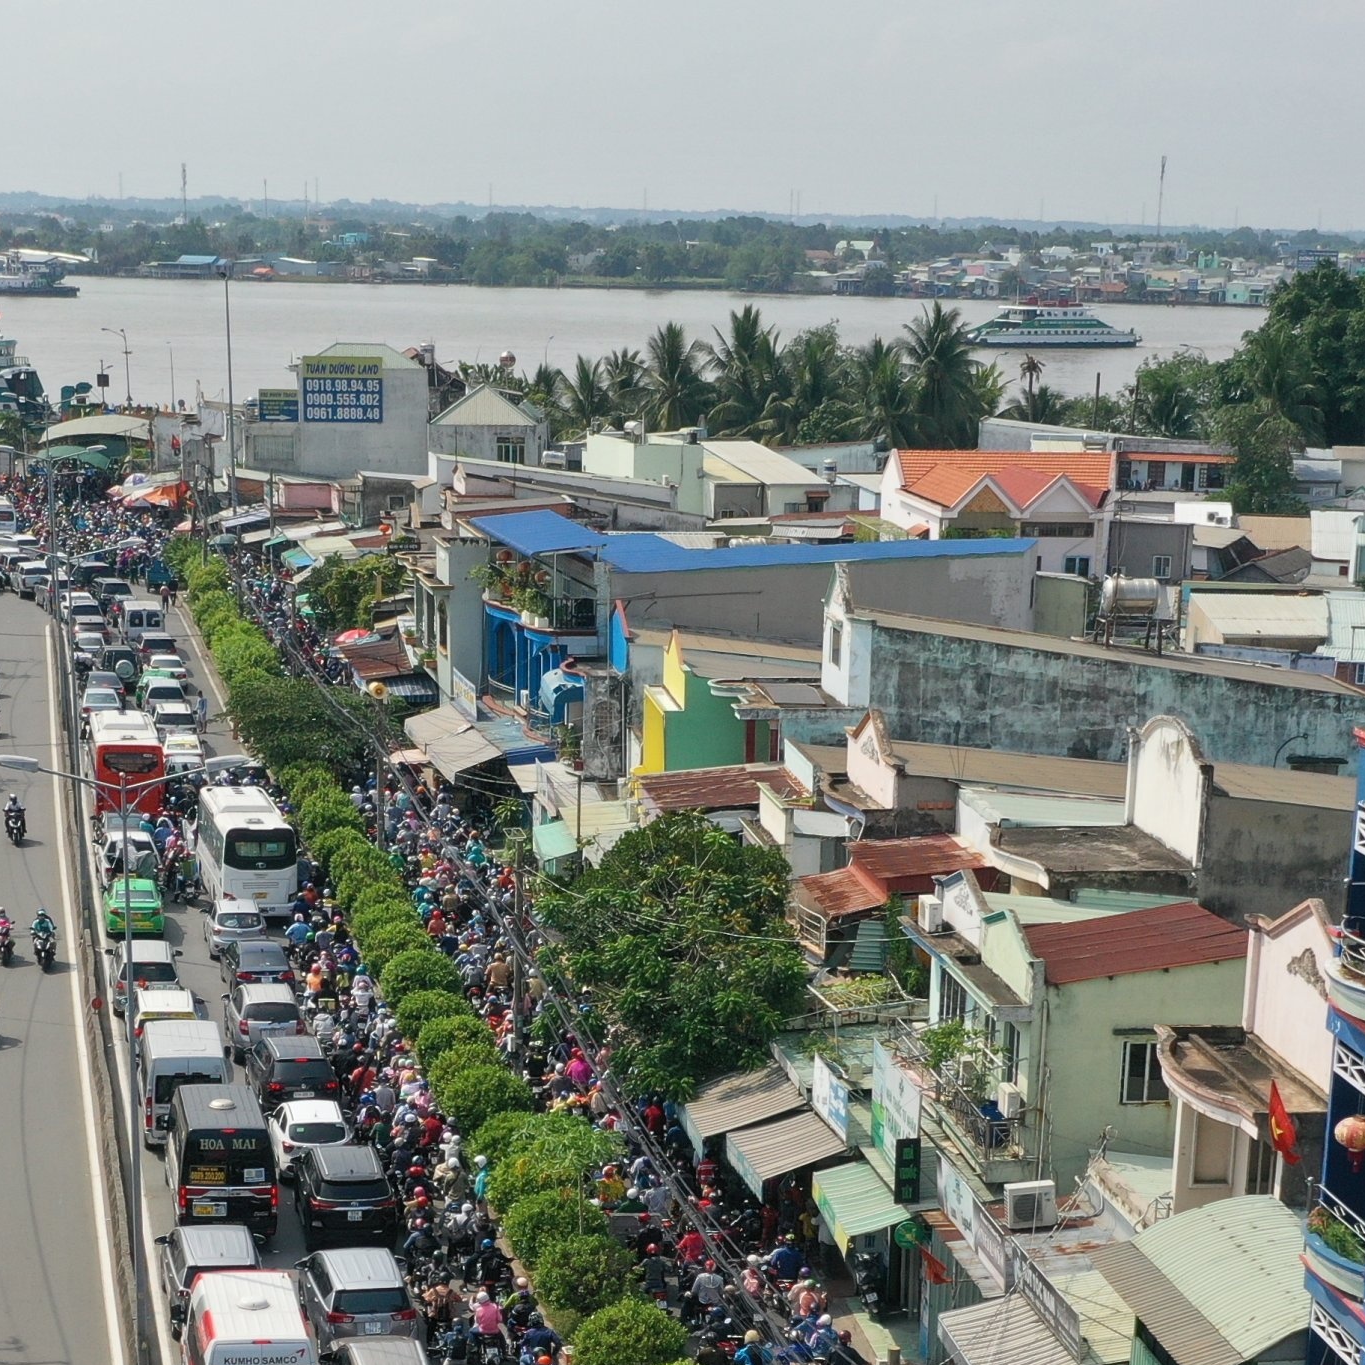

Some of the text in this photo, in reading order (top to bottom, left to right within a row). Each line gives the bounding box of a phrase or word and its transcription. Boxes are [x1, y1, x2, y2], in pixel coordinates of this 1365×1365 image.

[357, 364, 379, 375] LAND
[306, 379, 379, 391] 0918.98.94.95
[306, 394, 379, 405] 0909.555.802
[306, 407, 380, 419] 0961.8888.48
[200, 1139, 256, 1150] HOA MAI
[224, 1356, 297, 1365] KUMHO SAMCO
